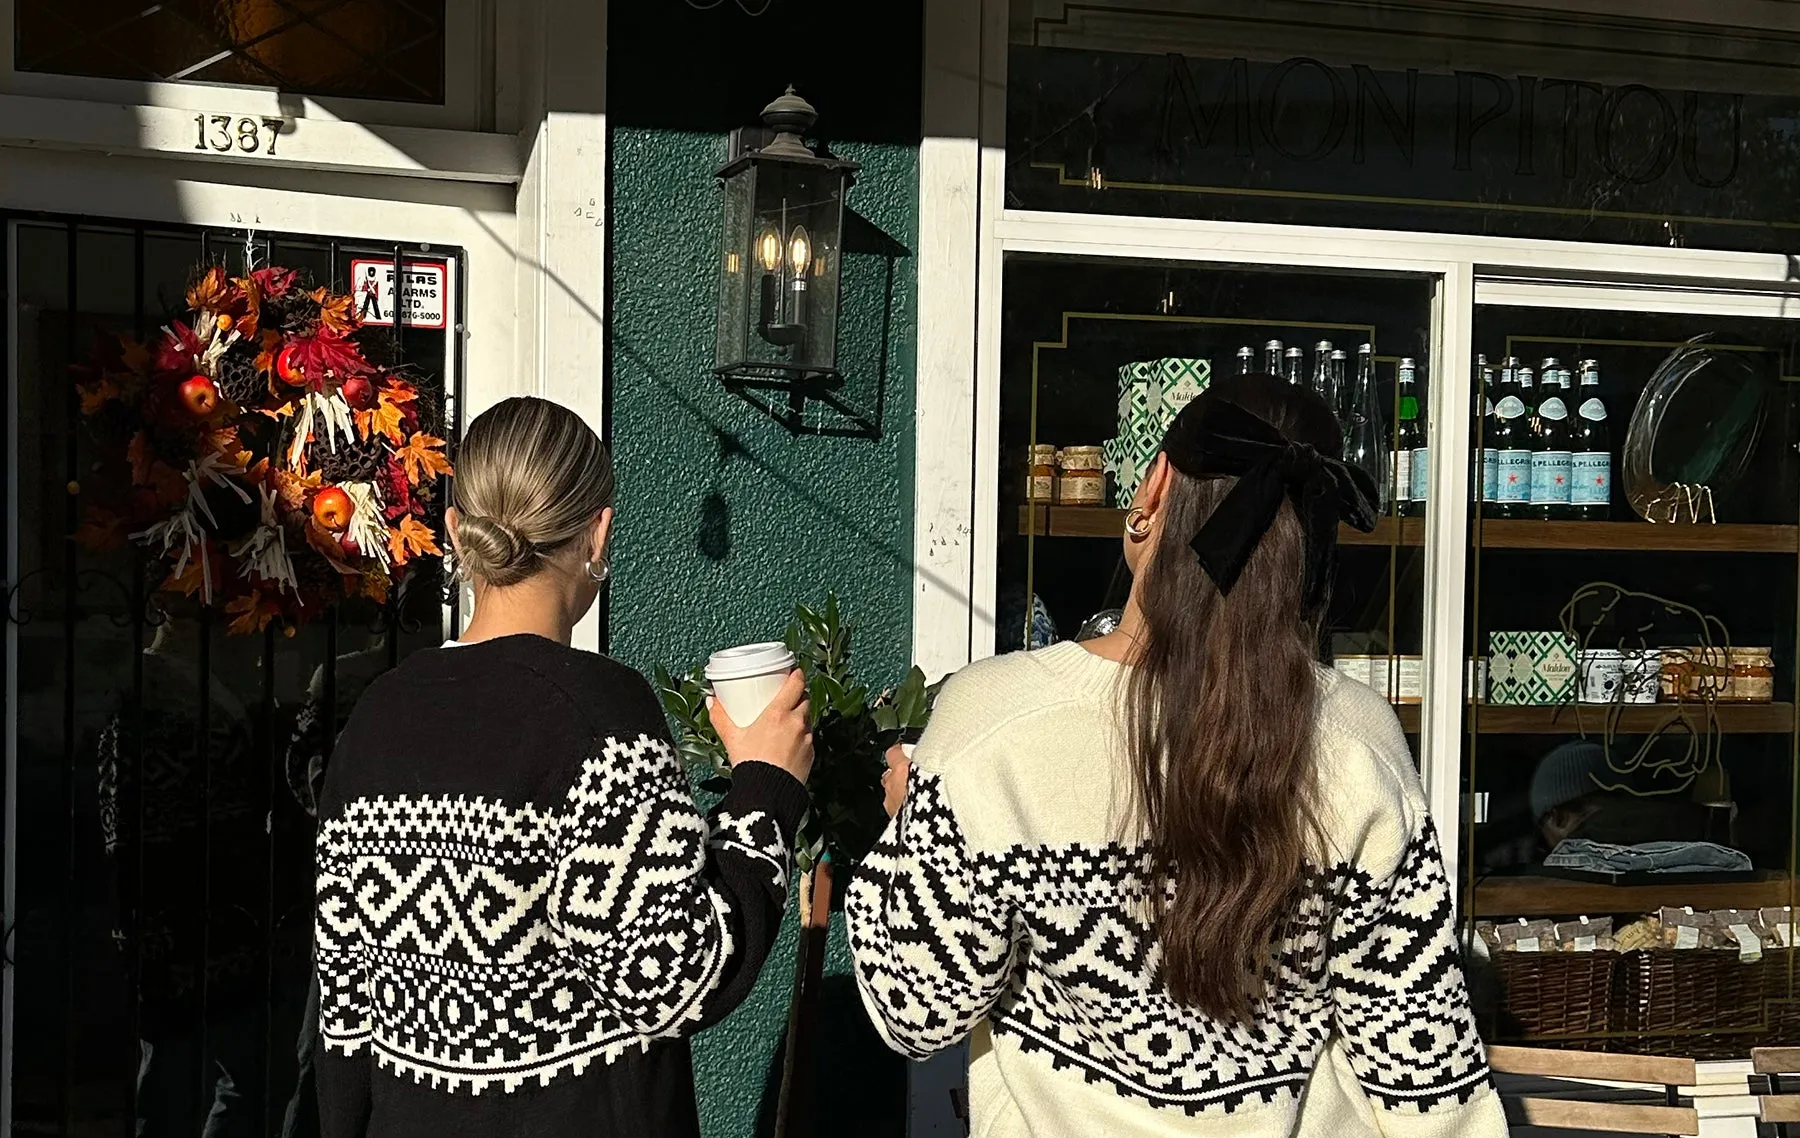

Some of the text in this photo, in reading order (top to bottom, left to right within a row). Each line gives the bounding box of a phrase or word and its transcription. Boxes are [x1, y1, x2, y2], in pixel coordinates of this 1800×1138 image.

[1156, 52, 1744, 189] MON PITOU
[194, 113, 285, 155] 1387
[386, 271, 437, 286] ALAS
[387, 287, 437, 298] AARMS
[1541, 663, 1572, 673] Maldon
